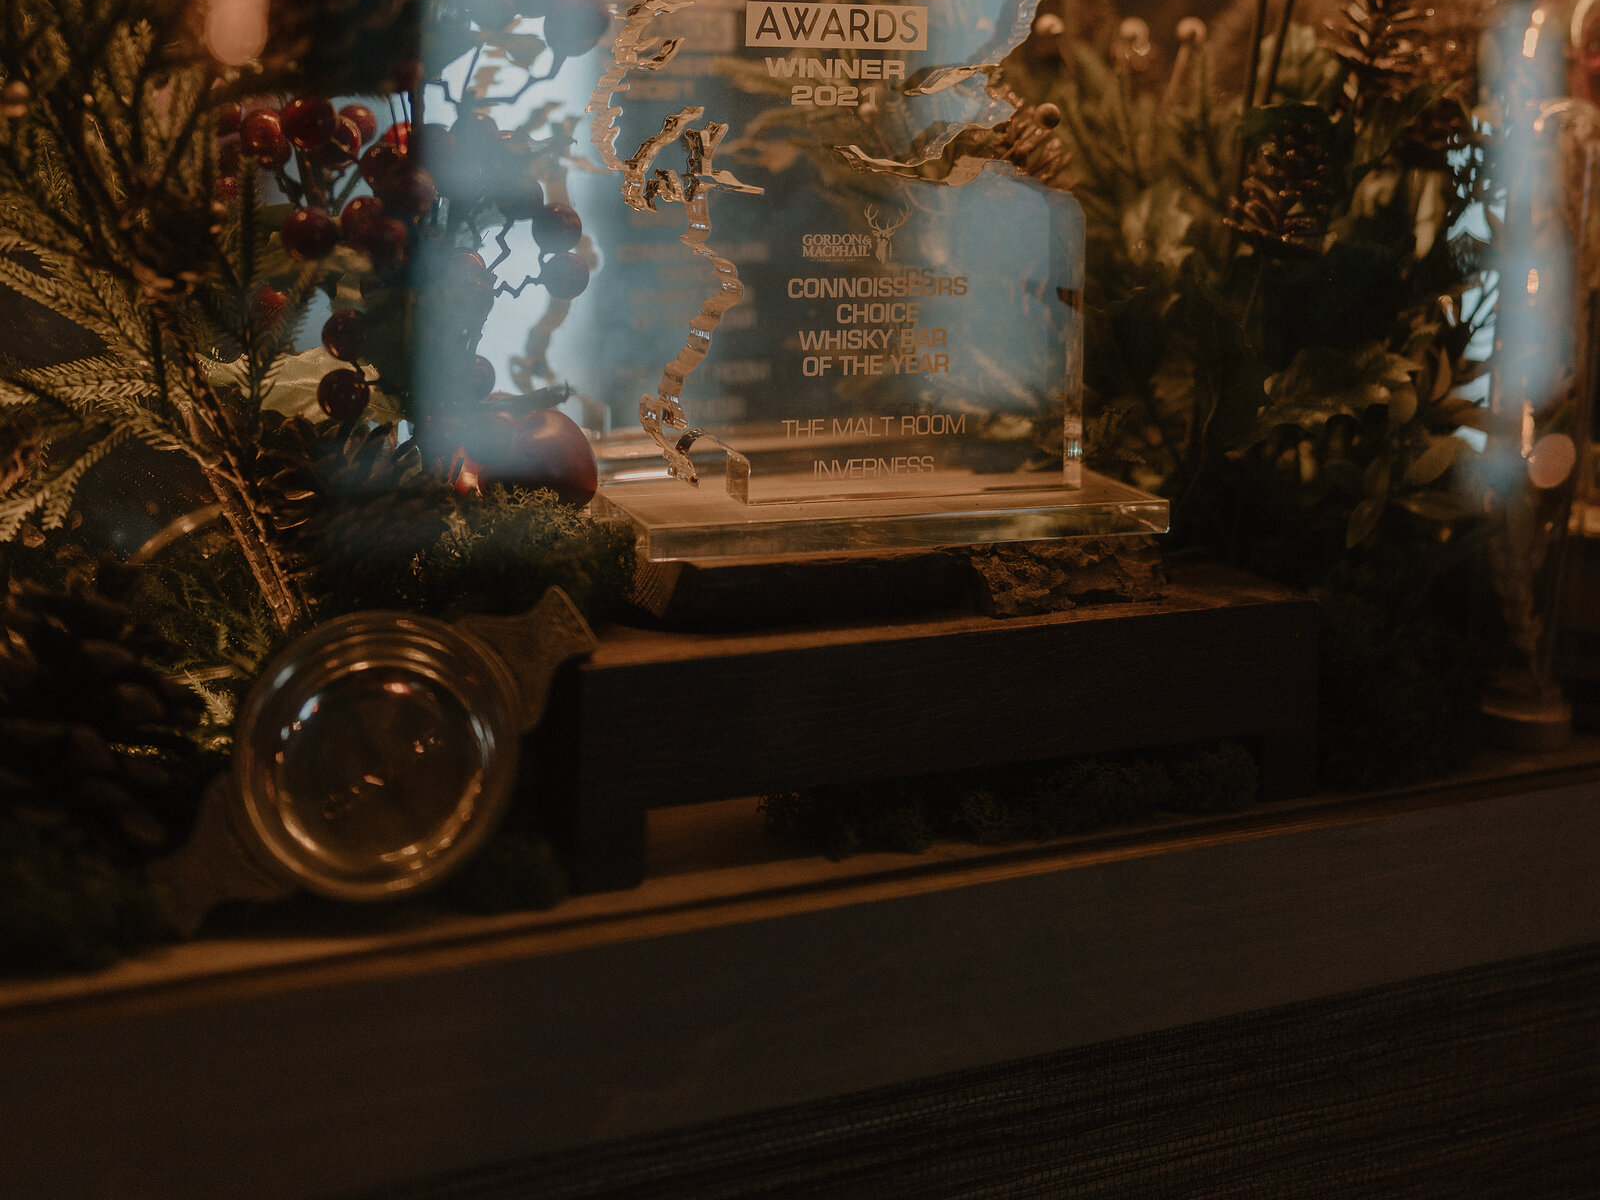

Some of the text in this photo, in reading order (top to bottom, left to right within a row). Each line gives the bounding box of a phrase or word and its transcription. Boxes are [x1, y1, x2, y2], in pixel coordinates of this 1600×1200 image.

[755, 6, 919, 43] AWARDS
[765, 57, 906, 80] WINNER
[791, 85, 876, 107] 2021
[787, 276, 968, 299] CONNOISSEURS
[836, 302, 920, 325] CHOICE
[799, 328, 948, 351] WHISKY BAR
[802, 353, 950, 377] OF THE YEAR
[781, 414, 967, 440] THE MALT ROOM
[813, 455, 935, 481] INVERNESS
